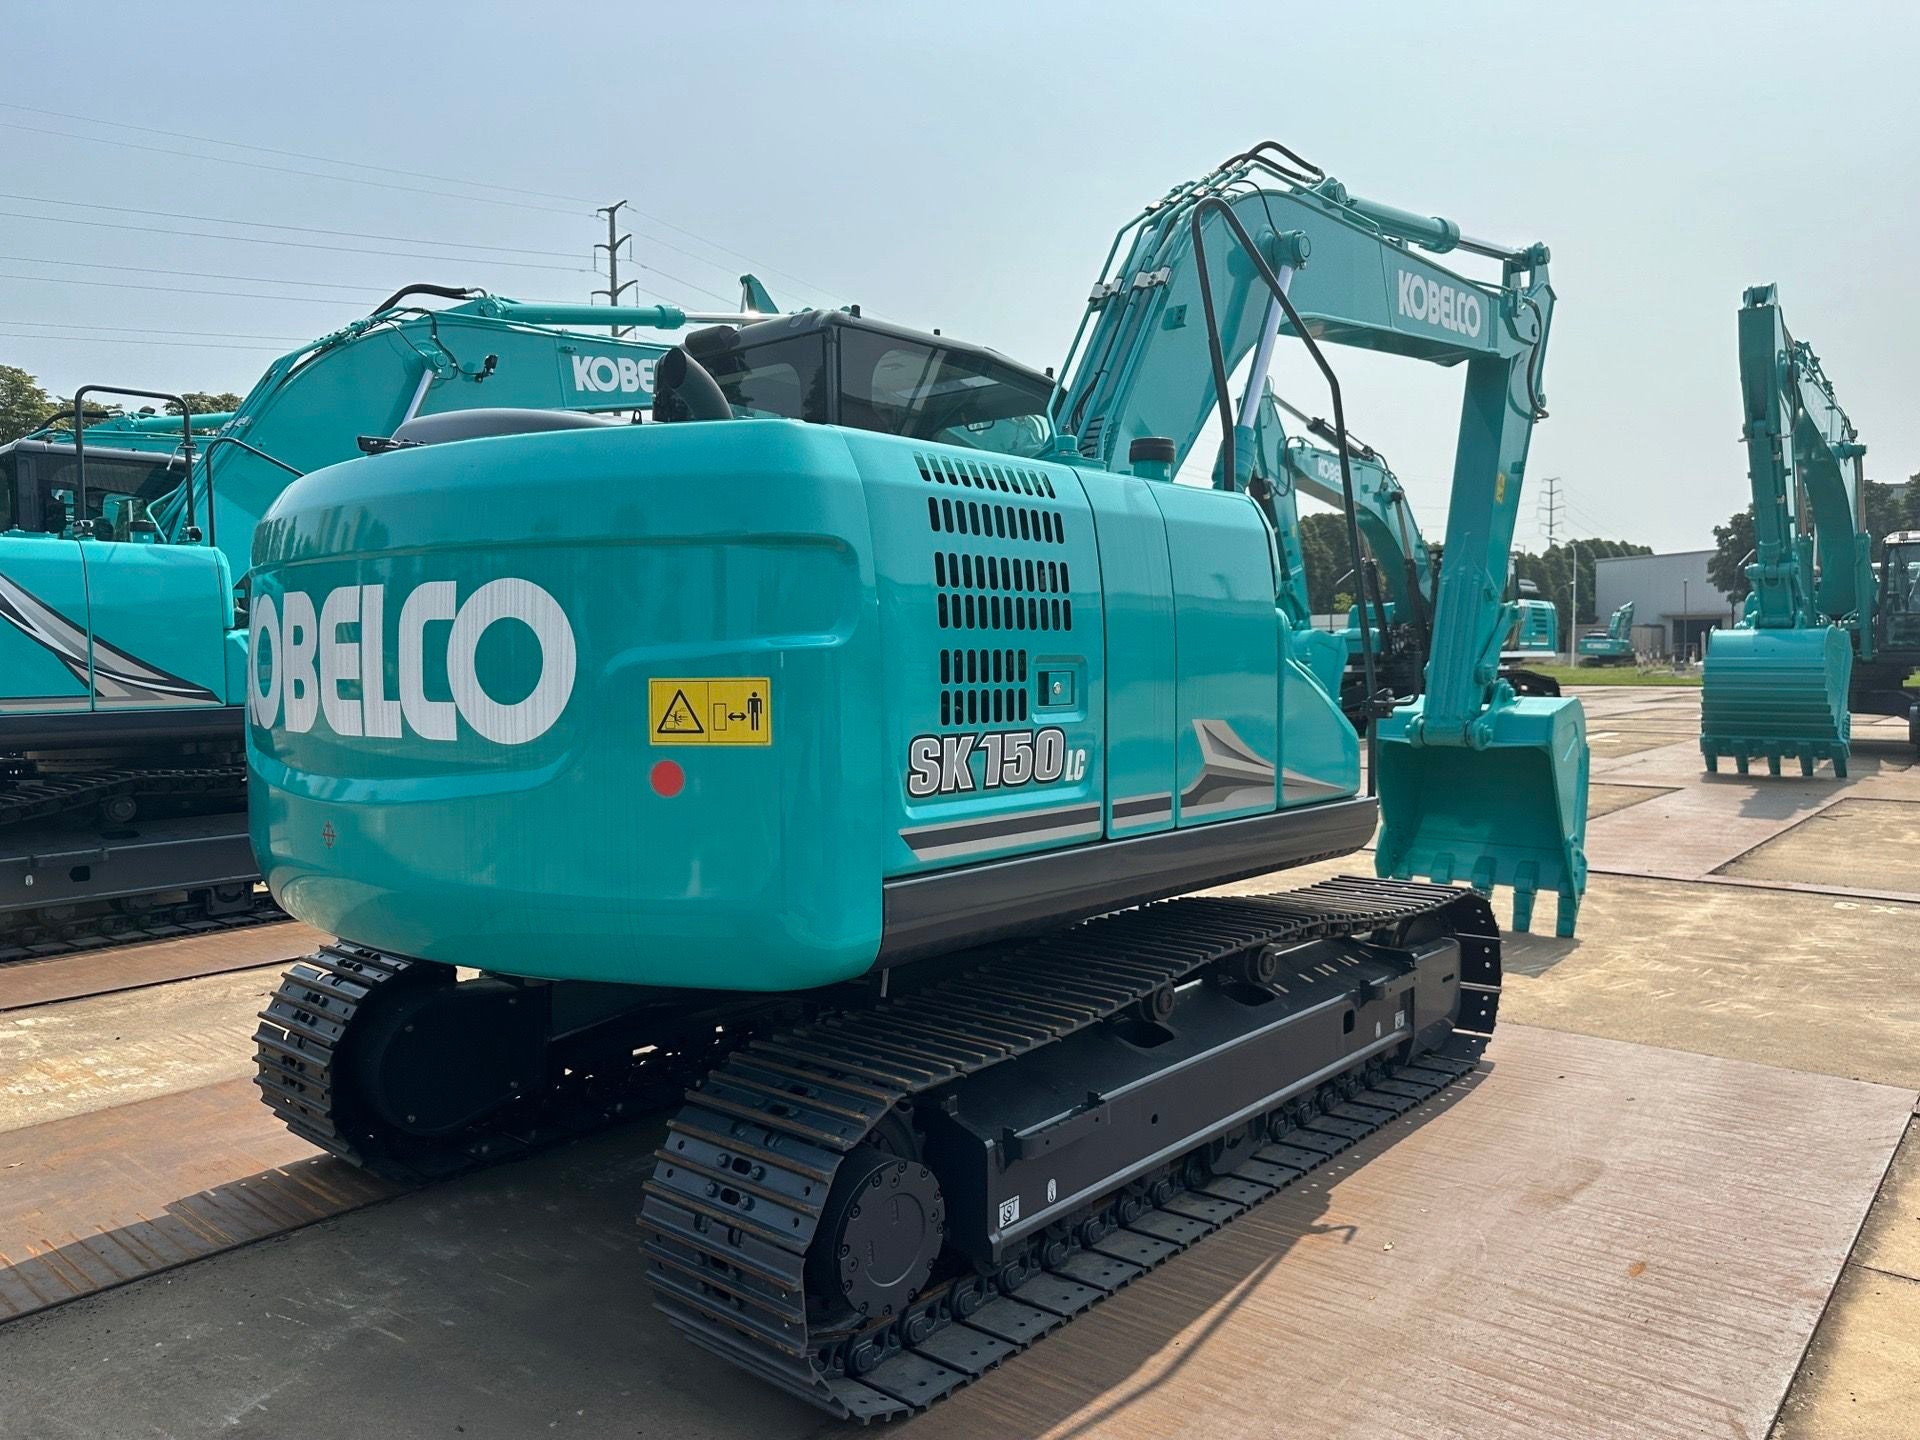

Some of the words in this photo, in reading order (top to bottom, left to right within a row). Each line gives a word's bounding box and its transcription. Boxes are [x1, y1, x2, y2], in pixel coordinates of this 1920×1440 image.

[1398, 269, 1481, 338] KOBELCO
[572, 355, 657, 393] KOBE
[1317, 457, 1343, 485] KOBE
[248, 577, 577, 745] OBELCO
[909, 727, 1066, 798] SK150
[1064, 748, 1087, 782] LC
